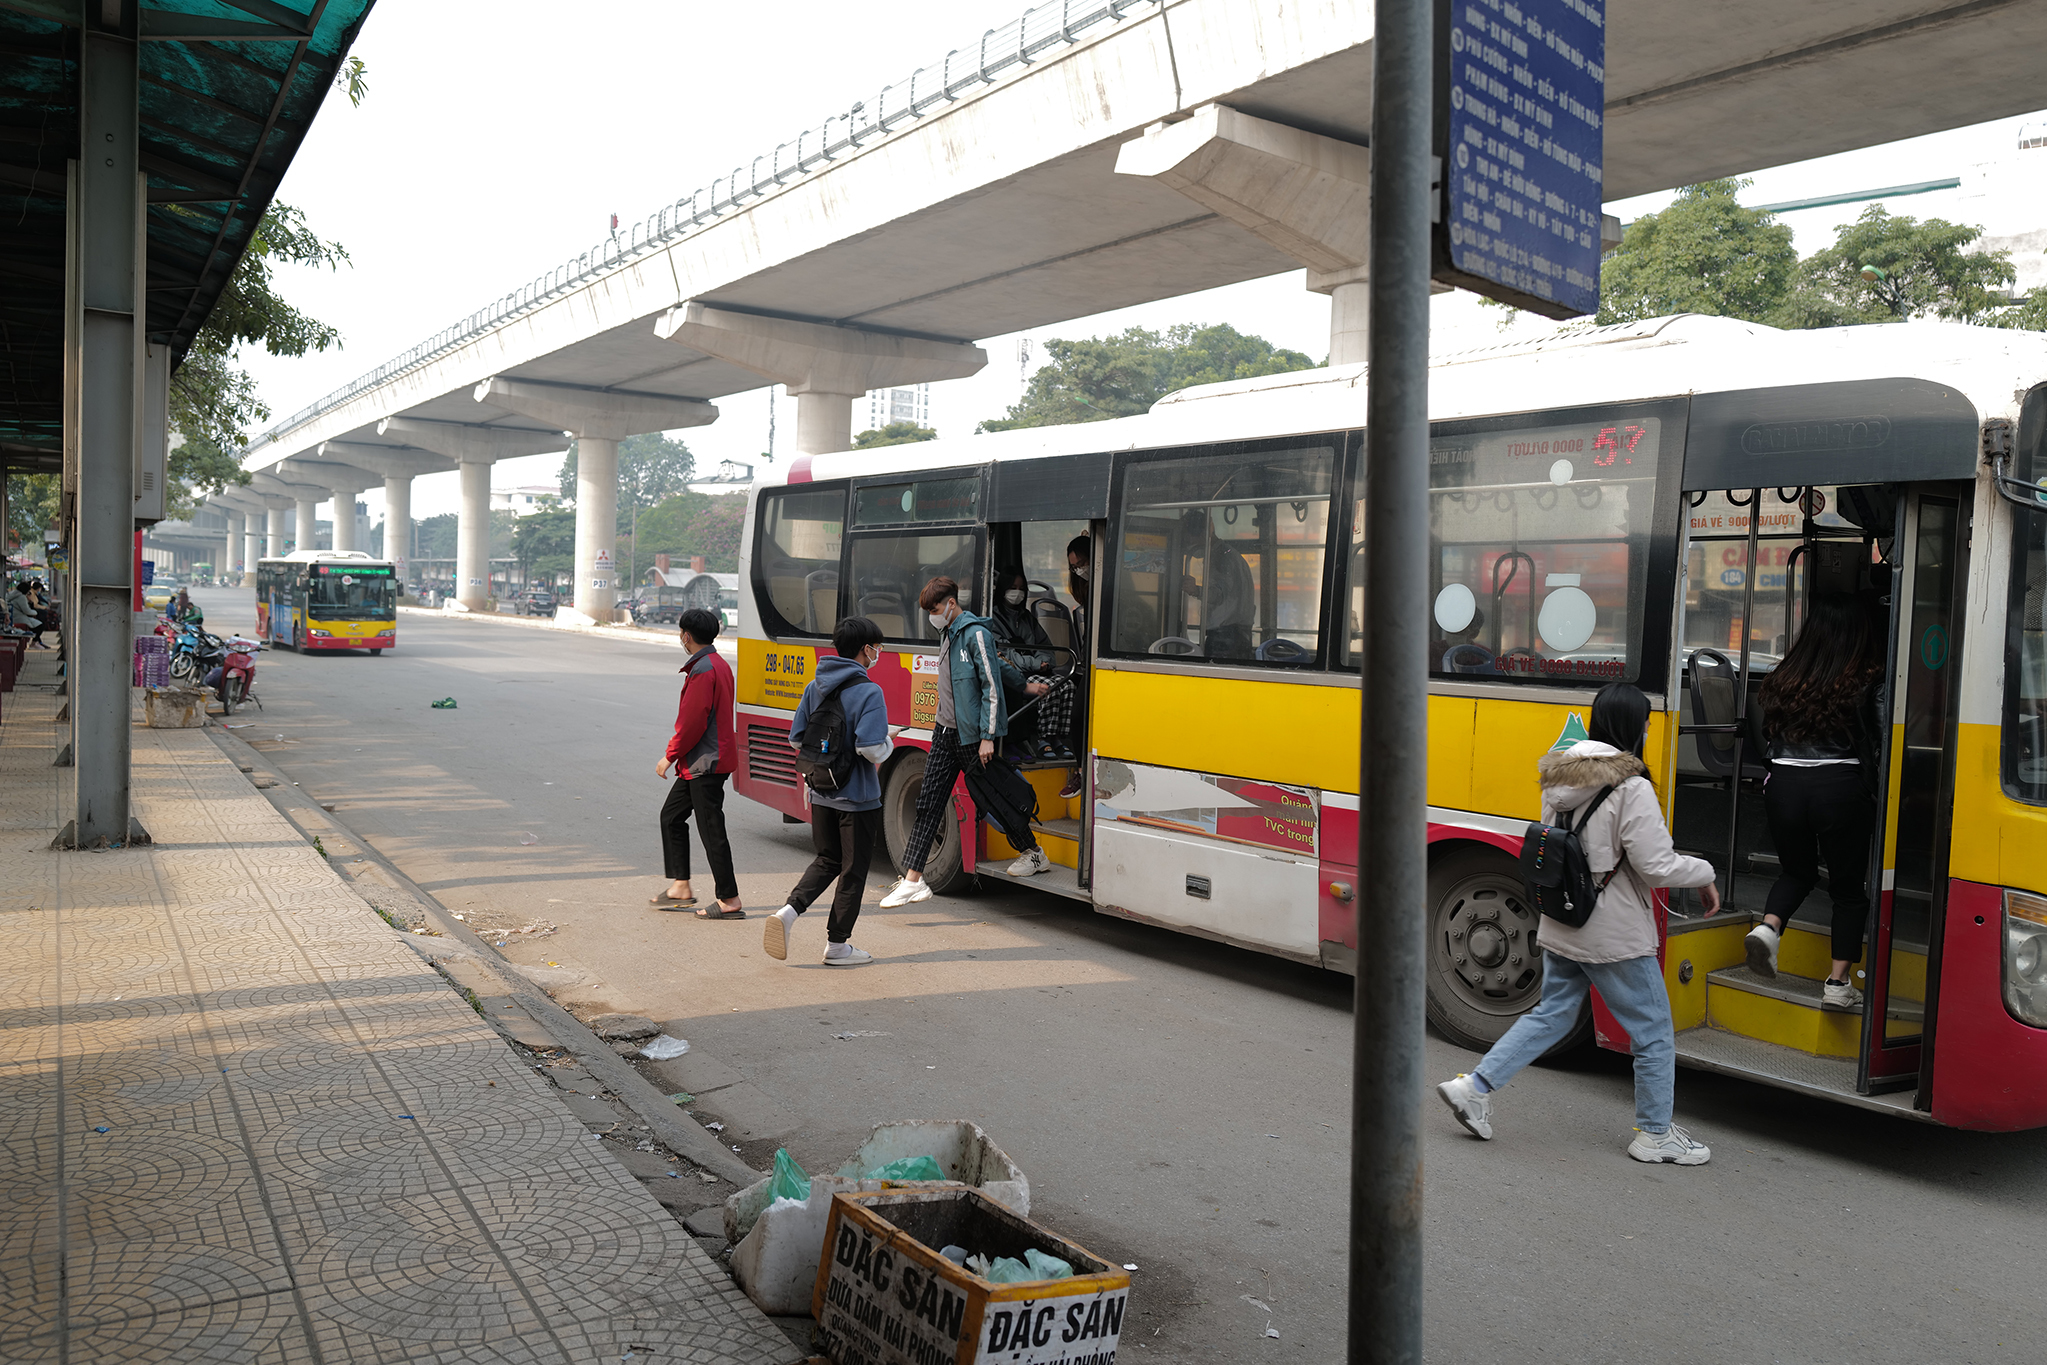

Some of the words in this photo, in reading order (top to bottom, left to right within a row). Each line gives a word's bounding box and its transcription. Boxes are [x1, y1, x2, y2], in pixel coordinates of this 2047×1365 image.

[1690, 515, 1708, 529] GIÁ
[1710, 515, 1723, 528] VÉ
[1728, 516, 1751, 527] 900
[319, 566, 329, 575] 49
[1724, 572, 1742, 584] 184
[593, 580, 607, 588] P37
[765, 653, 777, 672] 29B
[783, 655, 804, 675] 047.65
[1495, 654, 1516, 672] GIÁ
[1520, 655, 1536, 672] VÉ
[1540, 658, 1572, 674] 9000
[1576, 660, 1625, 680] Đ/LƯỢT
[914, 691, 936, 707] 0976
[1264, 816, 1285, 835] TVC
[1287, 828, 1314, 846] trong
[836, 1223, 893, 1292] ĐẶC
[831, 1314, 858, 1341] QUANG
[860, 1334, 881, 1359] VINH
[883, 1313, 907, 1349] HẢI
[987, 1299, 1055, 1360] ĐẶC
